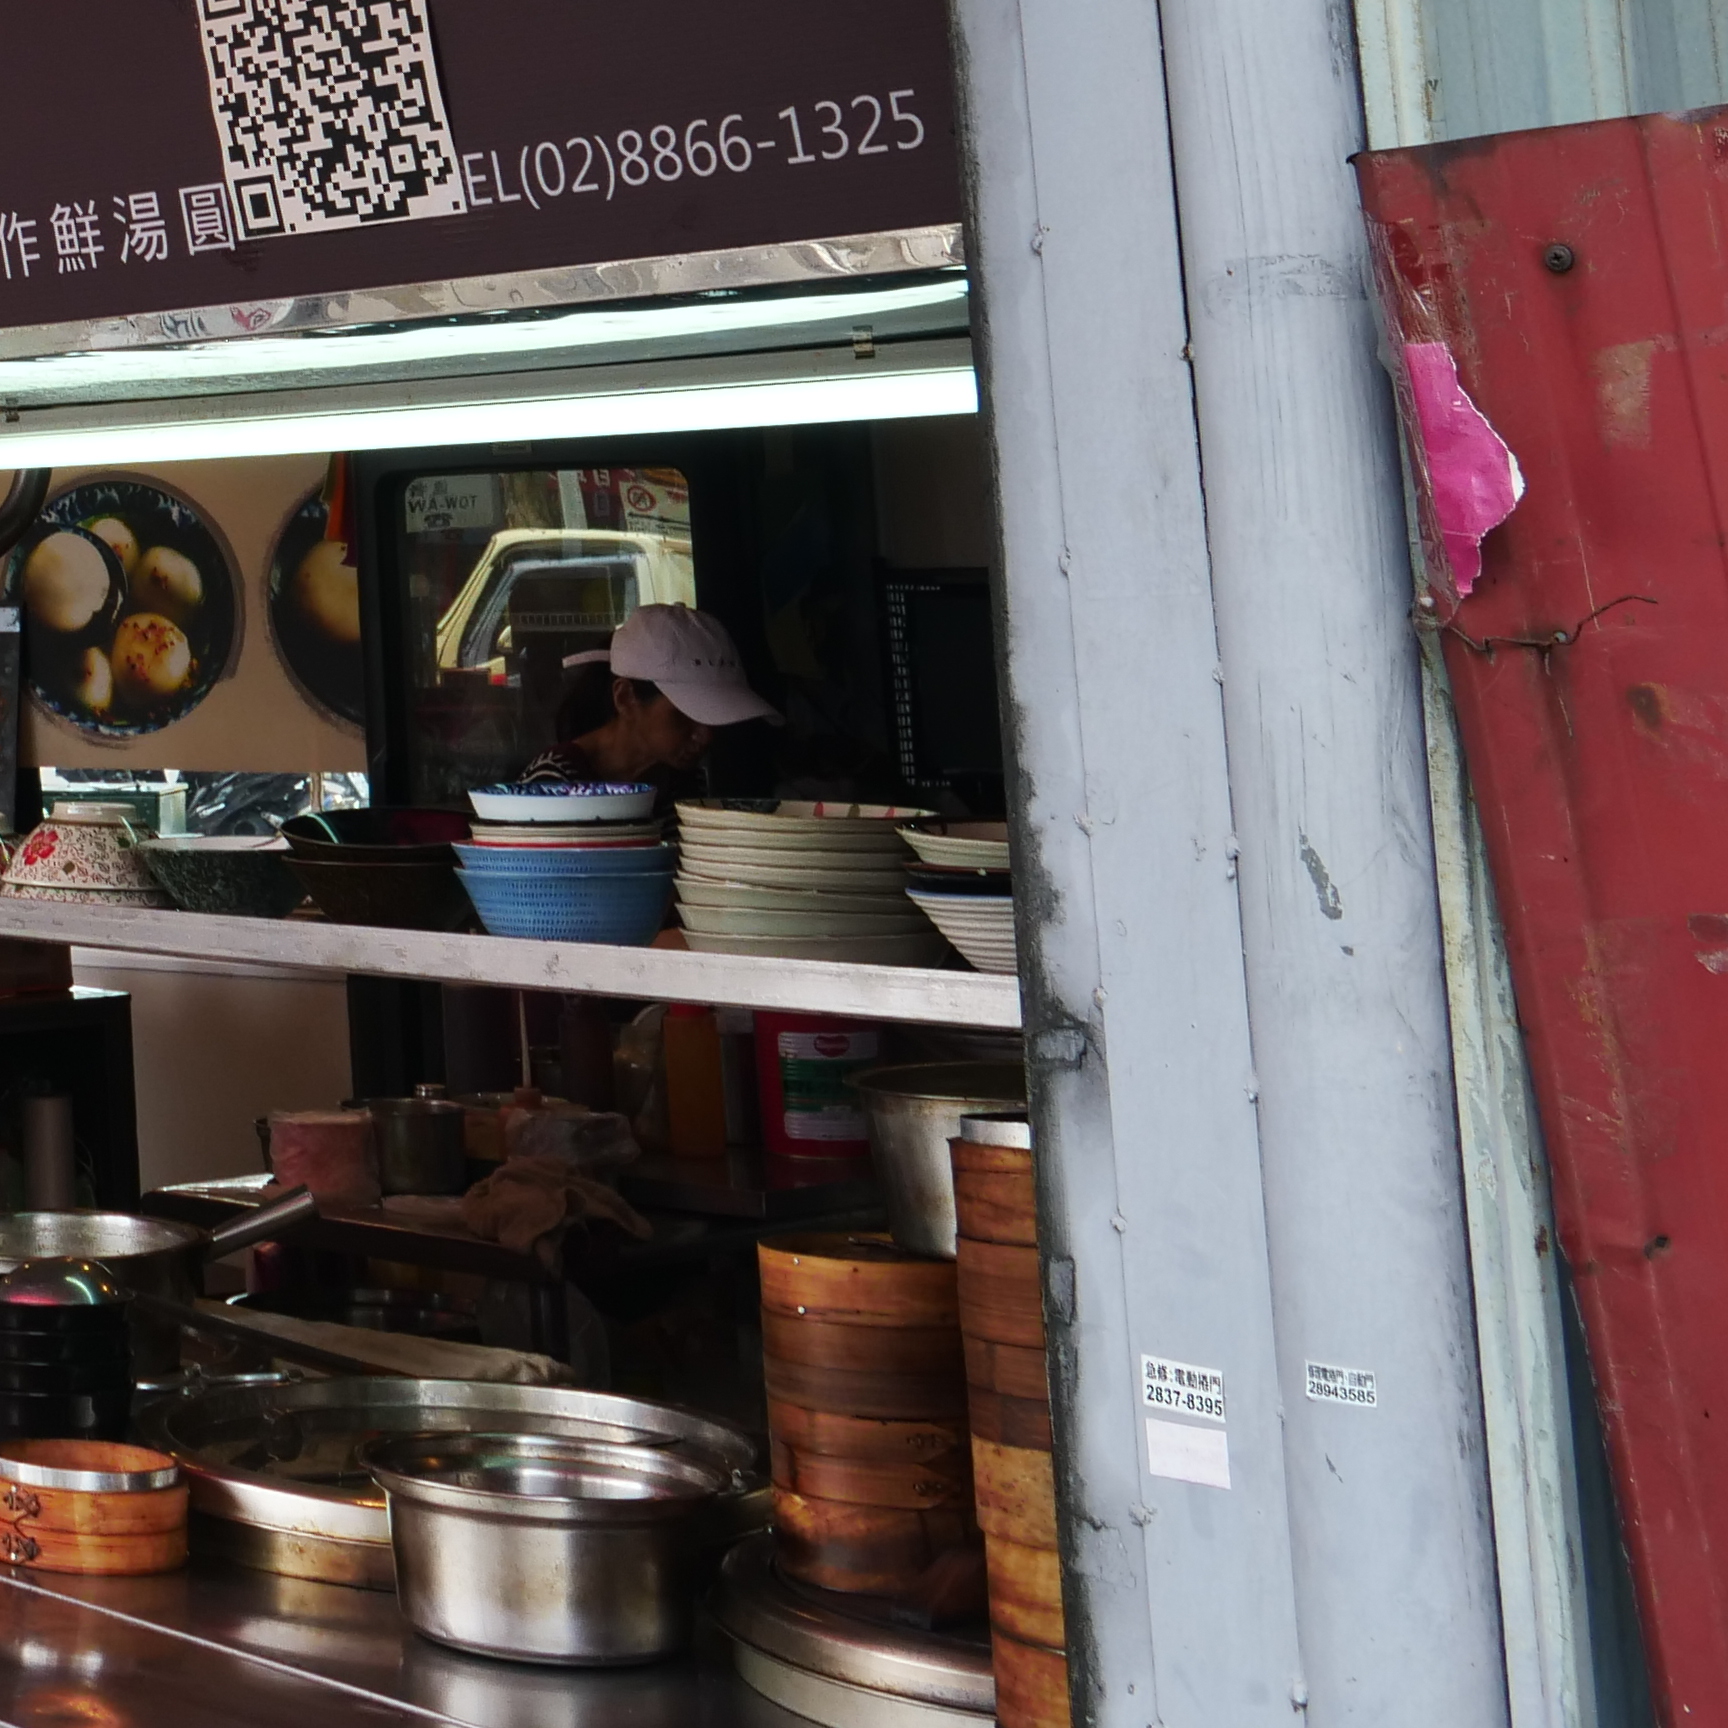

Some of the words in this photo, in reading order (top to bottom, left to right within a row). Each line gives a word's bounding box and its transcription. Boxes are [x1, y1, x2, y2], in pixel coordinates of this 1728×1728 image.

[462, 90, 926, 208] EL(02)8866-1325
[1146, 1384, 1223, 1417] 2837-8395
[1308, 1380, 1376, 1405] 28943585
